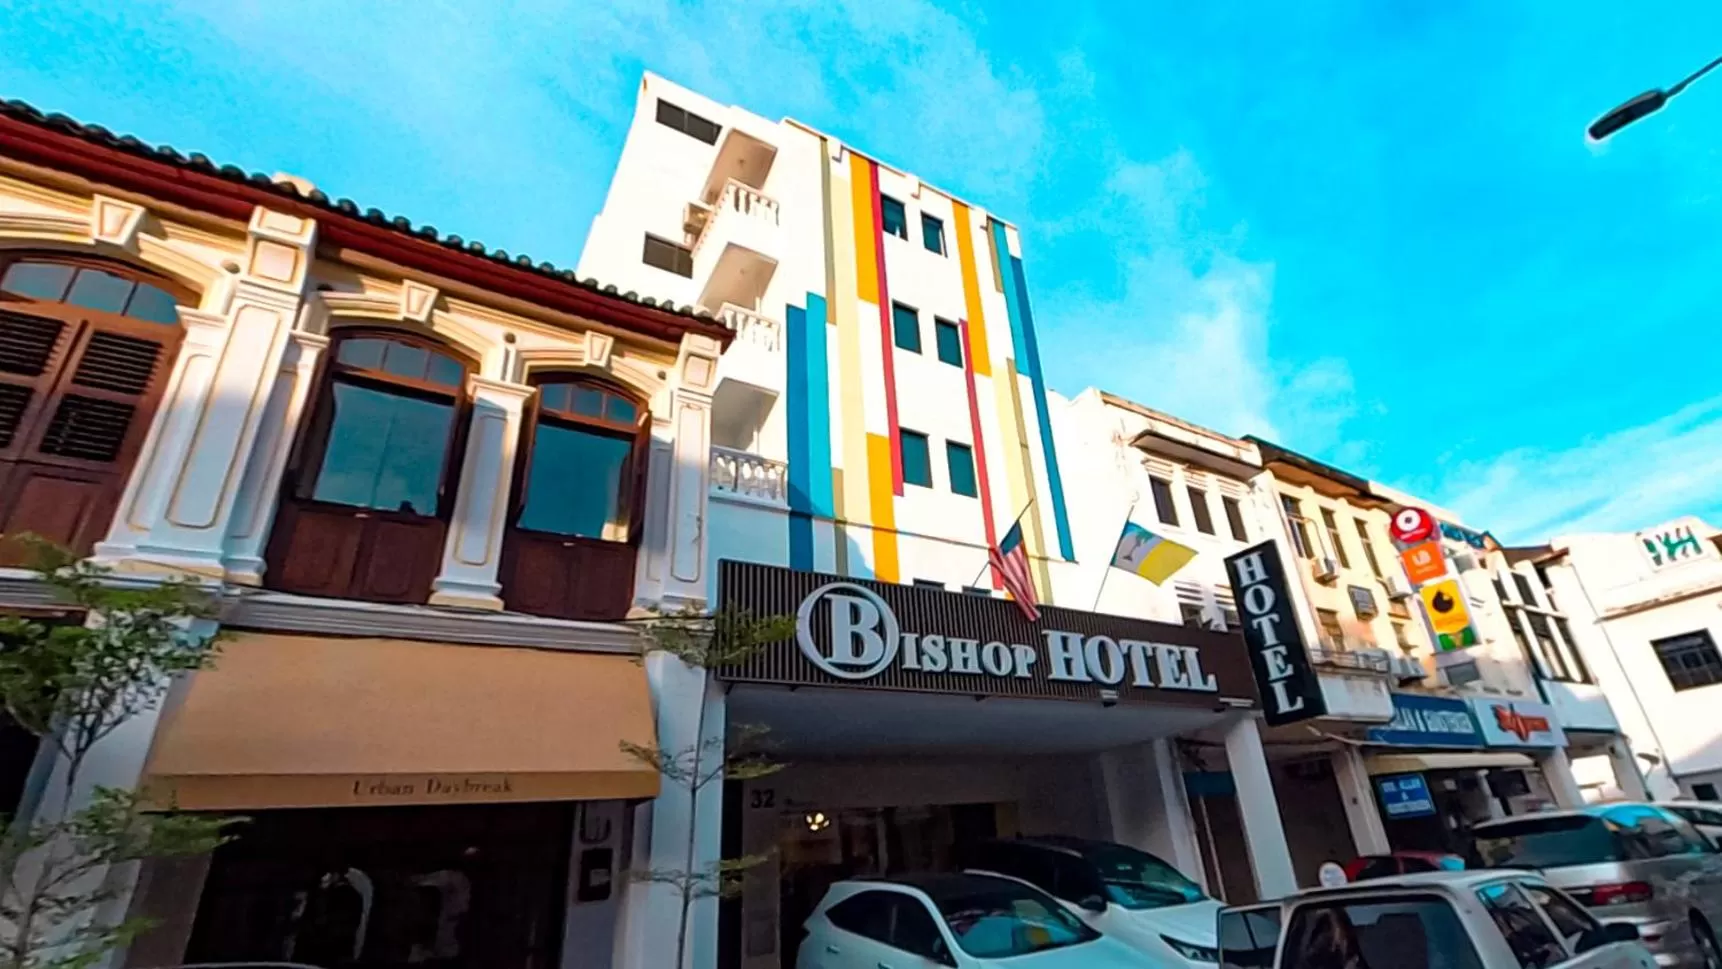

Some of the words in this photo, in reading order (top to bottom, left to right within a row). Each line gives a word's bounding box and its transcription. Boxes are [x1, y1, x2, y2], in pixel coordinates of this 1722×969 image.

[1234, 551, 1304, 715] HOTEL
[1041, 629, 1218, 693] HOTEL
[354, 780, 415, 795] Urban
[427, 778, 512, 794] Daybreak
[751, 789, 775, 809] 32
